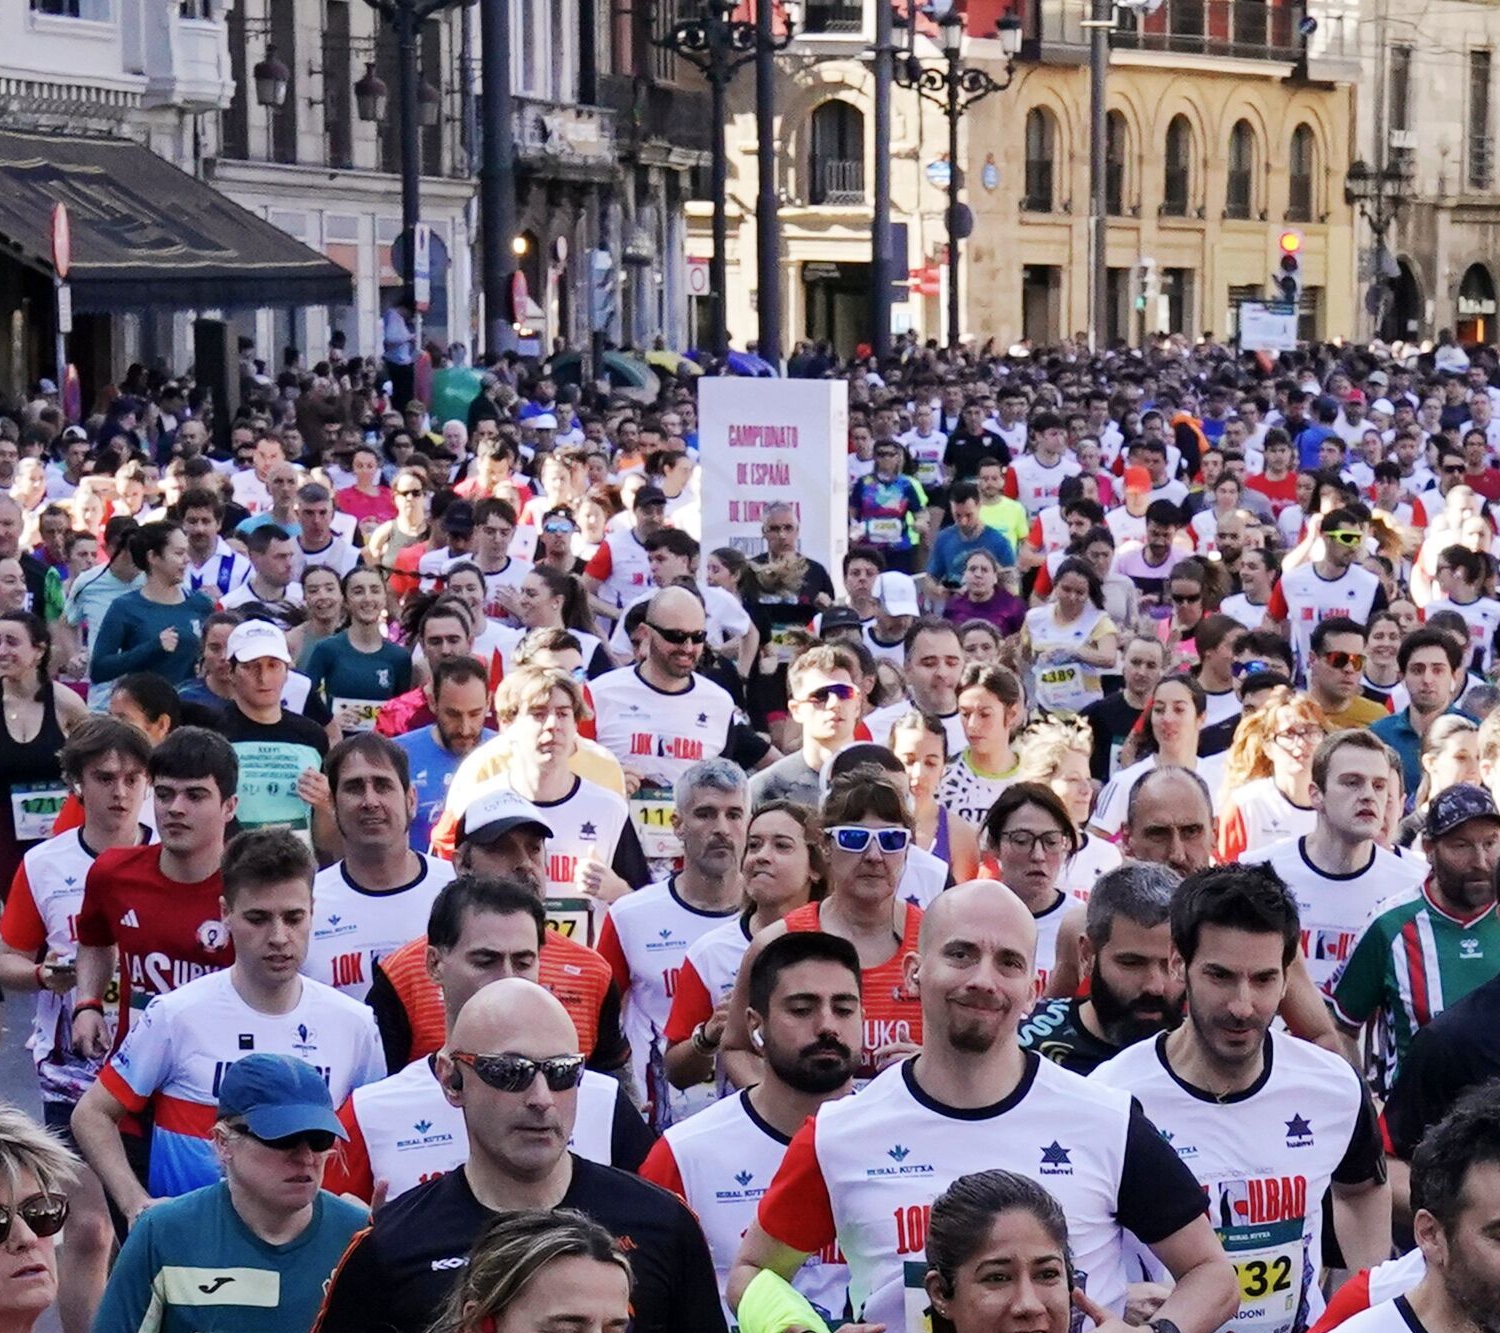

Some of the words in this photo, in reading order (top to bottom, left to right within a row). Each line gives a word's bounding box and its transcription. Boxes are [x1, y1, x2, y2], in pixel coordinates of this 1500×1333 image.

[728, 424, 799, 449] CAMPEONATO
[751, 459, 791, 486] ESPAÑA
[1233, 1254, 1292, 1299] 32
